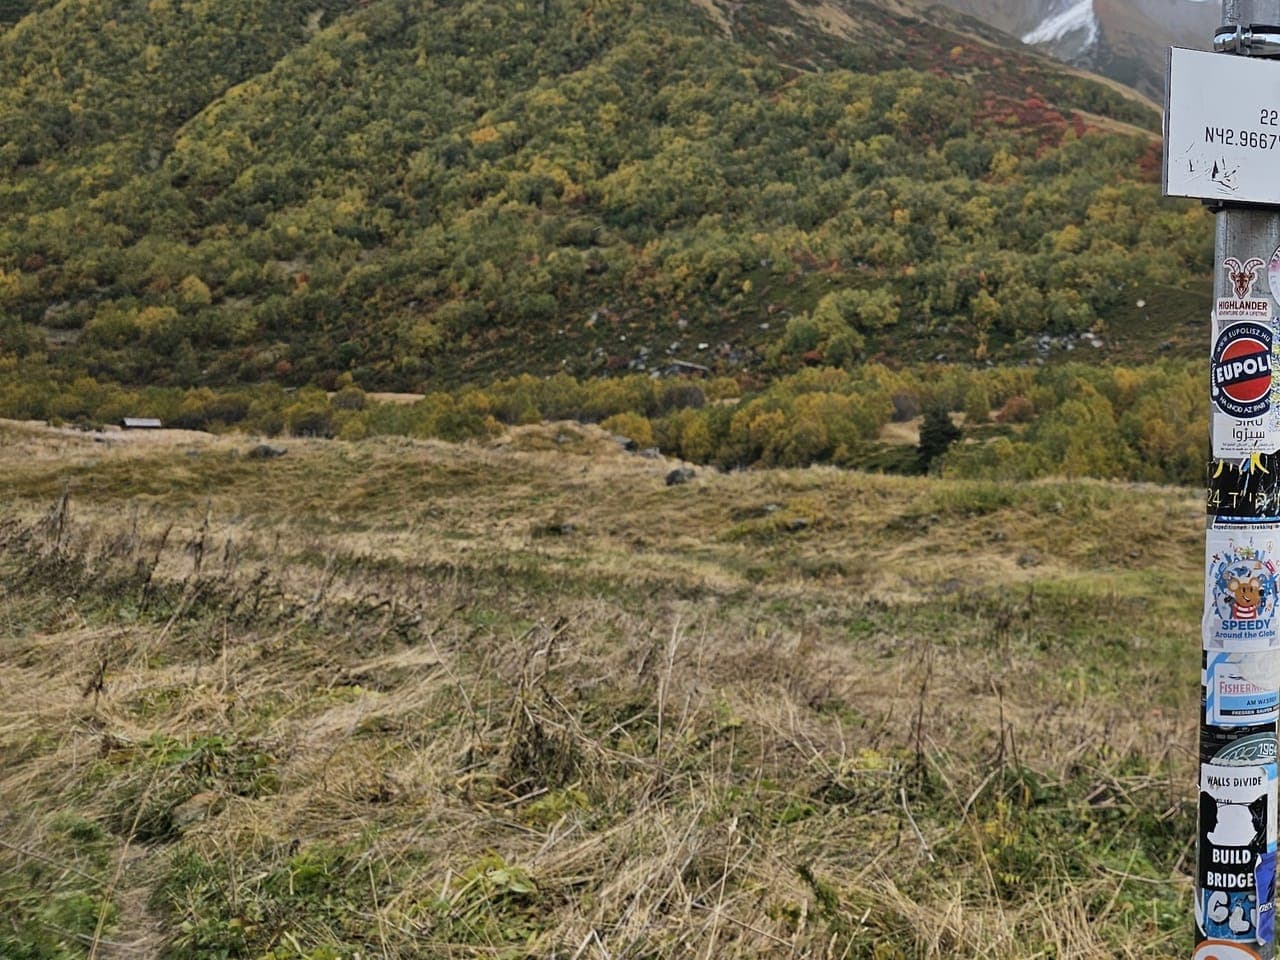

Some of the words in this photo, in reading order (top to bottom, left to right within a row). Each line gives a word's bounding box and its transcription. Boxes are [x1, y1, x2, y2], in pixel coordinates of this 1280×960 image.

[1218, 300, 1268, 311] HIGHLANDER
[1221, 619, 1271, 631] SPEEDY
[1215, 630, 1243, 639] Around
[1244, 631, 1258, 639] the
[1246, 699, 1257, 707] AM
[1207, 776, 1231, 787] WALLS
[1233, 776, 1263, 787] DIVIDE
[1212, 848, 1252, 865] BUILD
[1206, 870, 1254, 889] BRIDGE
